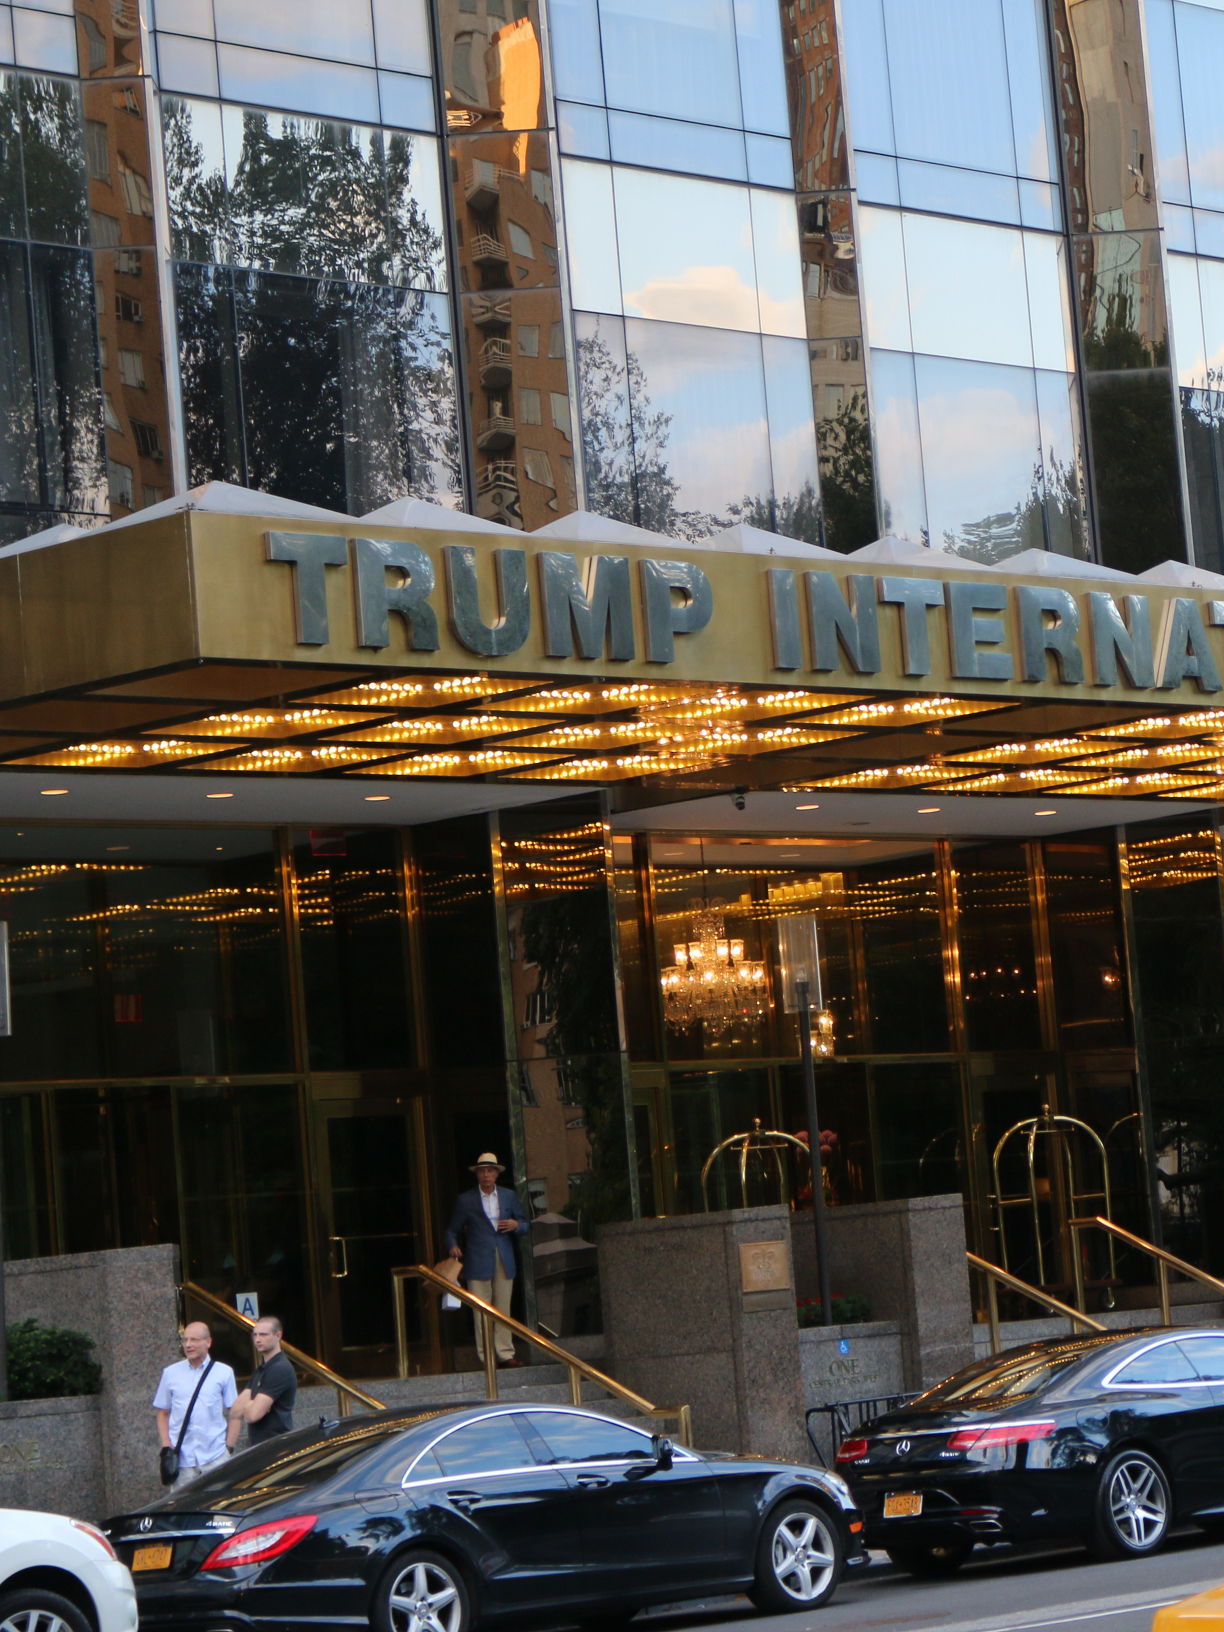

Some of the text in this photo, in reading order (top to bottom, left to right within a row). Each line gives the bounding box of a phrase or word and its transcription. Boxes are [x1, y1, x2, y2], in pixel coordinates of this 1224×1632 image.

[264, 530, 714, 665] TRUMP
[242, 1297, 255, 1316] A
[829, 1358, 860, 1377] ONE
